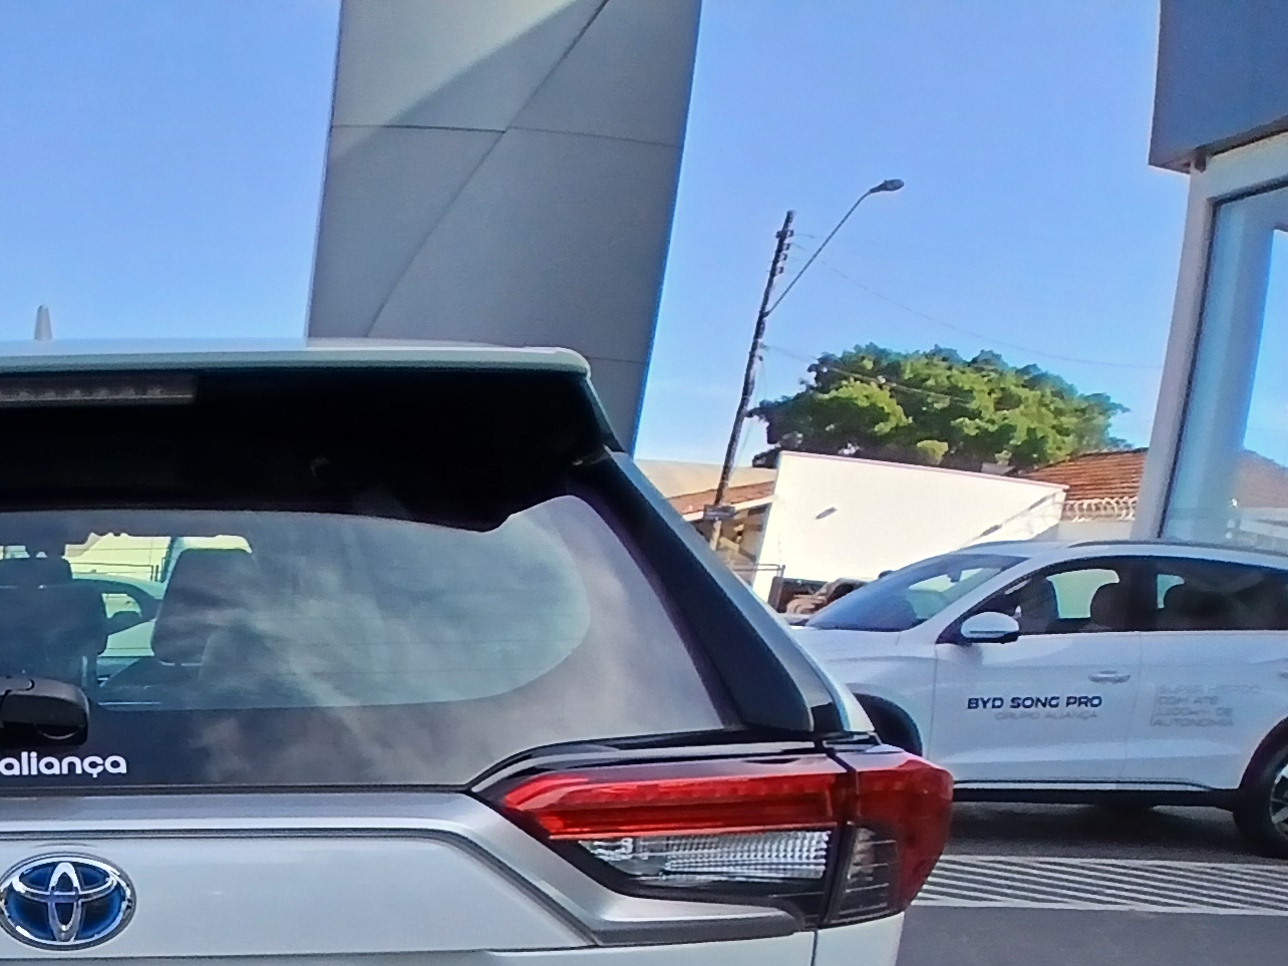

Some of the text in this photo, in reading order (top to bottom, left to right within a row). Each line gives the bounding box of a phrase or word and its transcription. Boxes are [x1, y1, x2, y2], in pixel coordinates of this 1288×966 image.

[967, 695, 1103, 709] BYD SONG PRO
